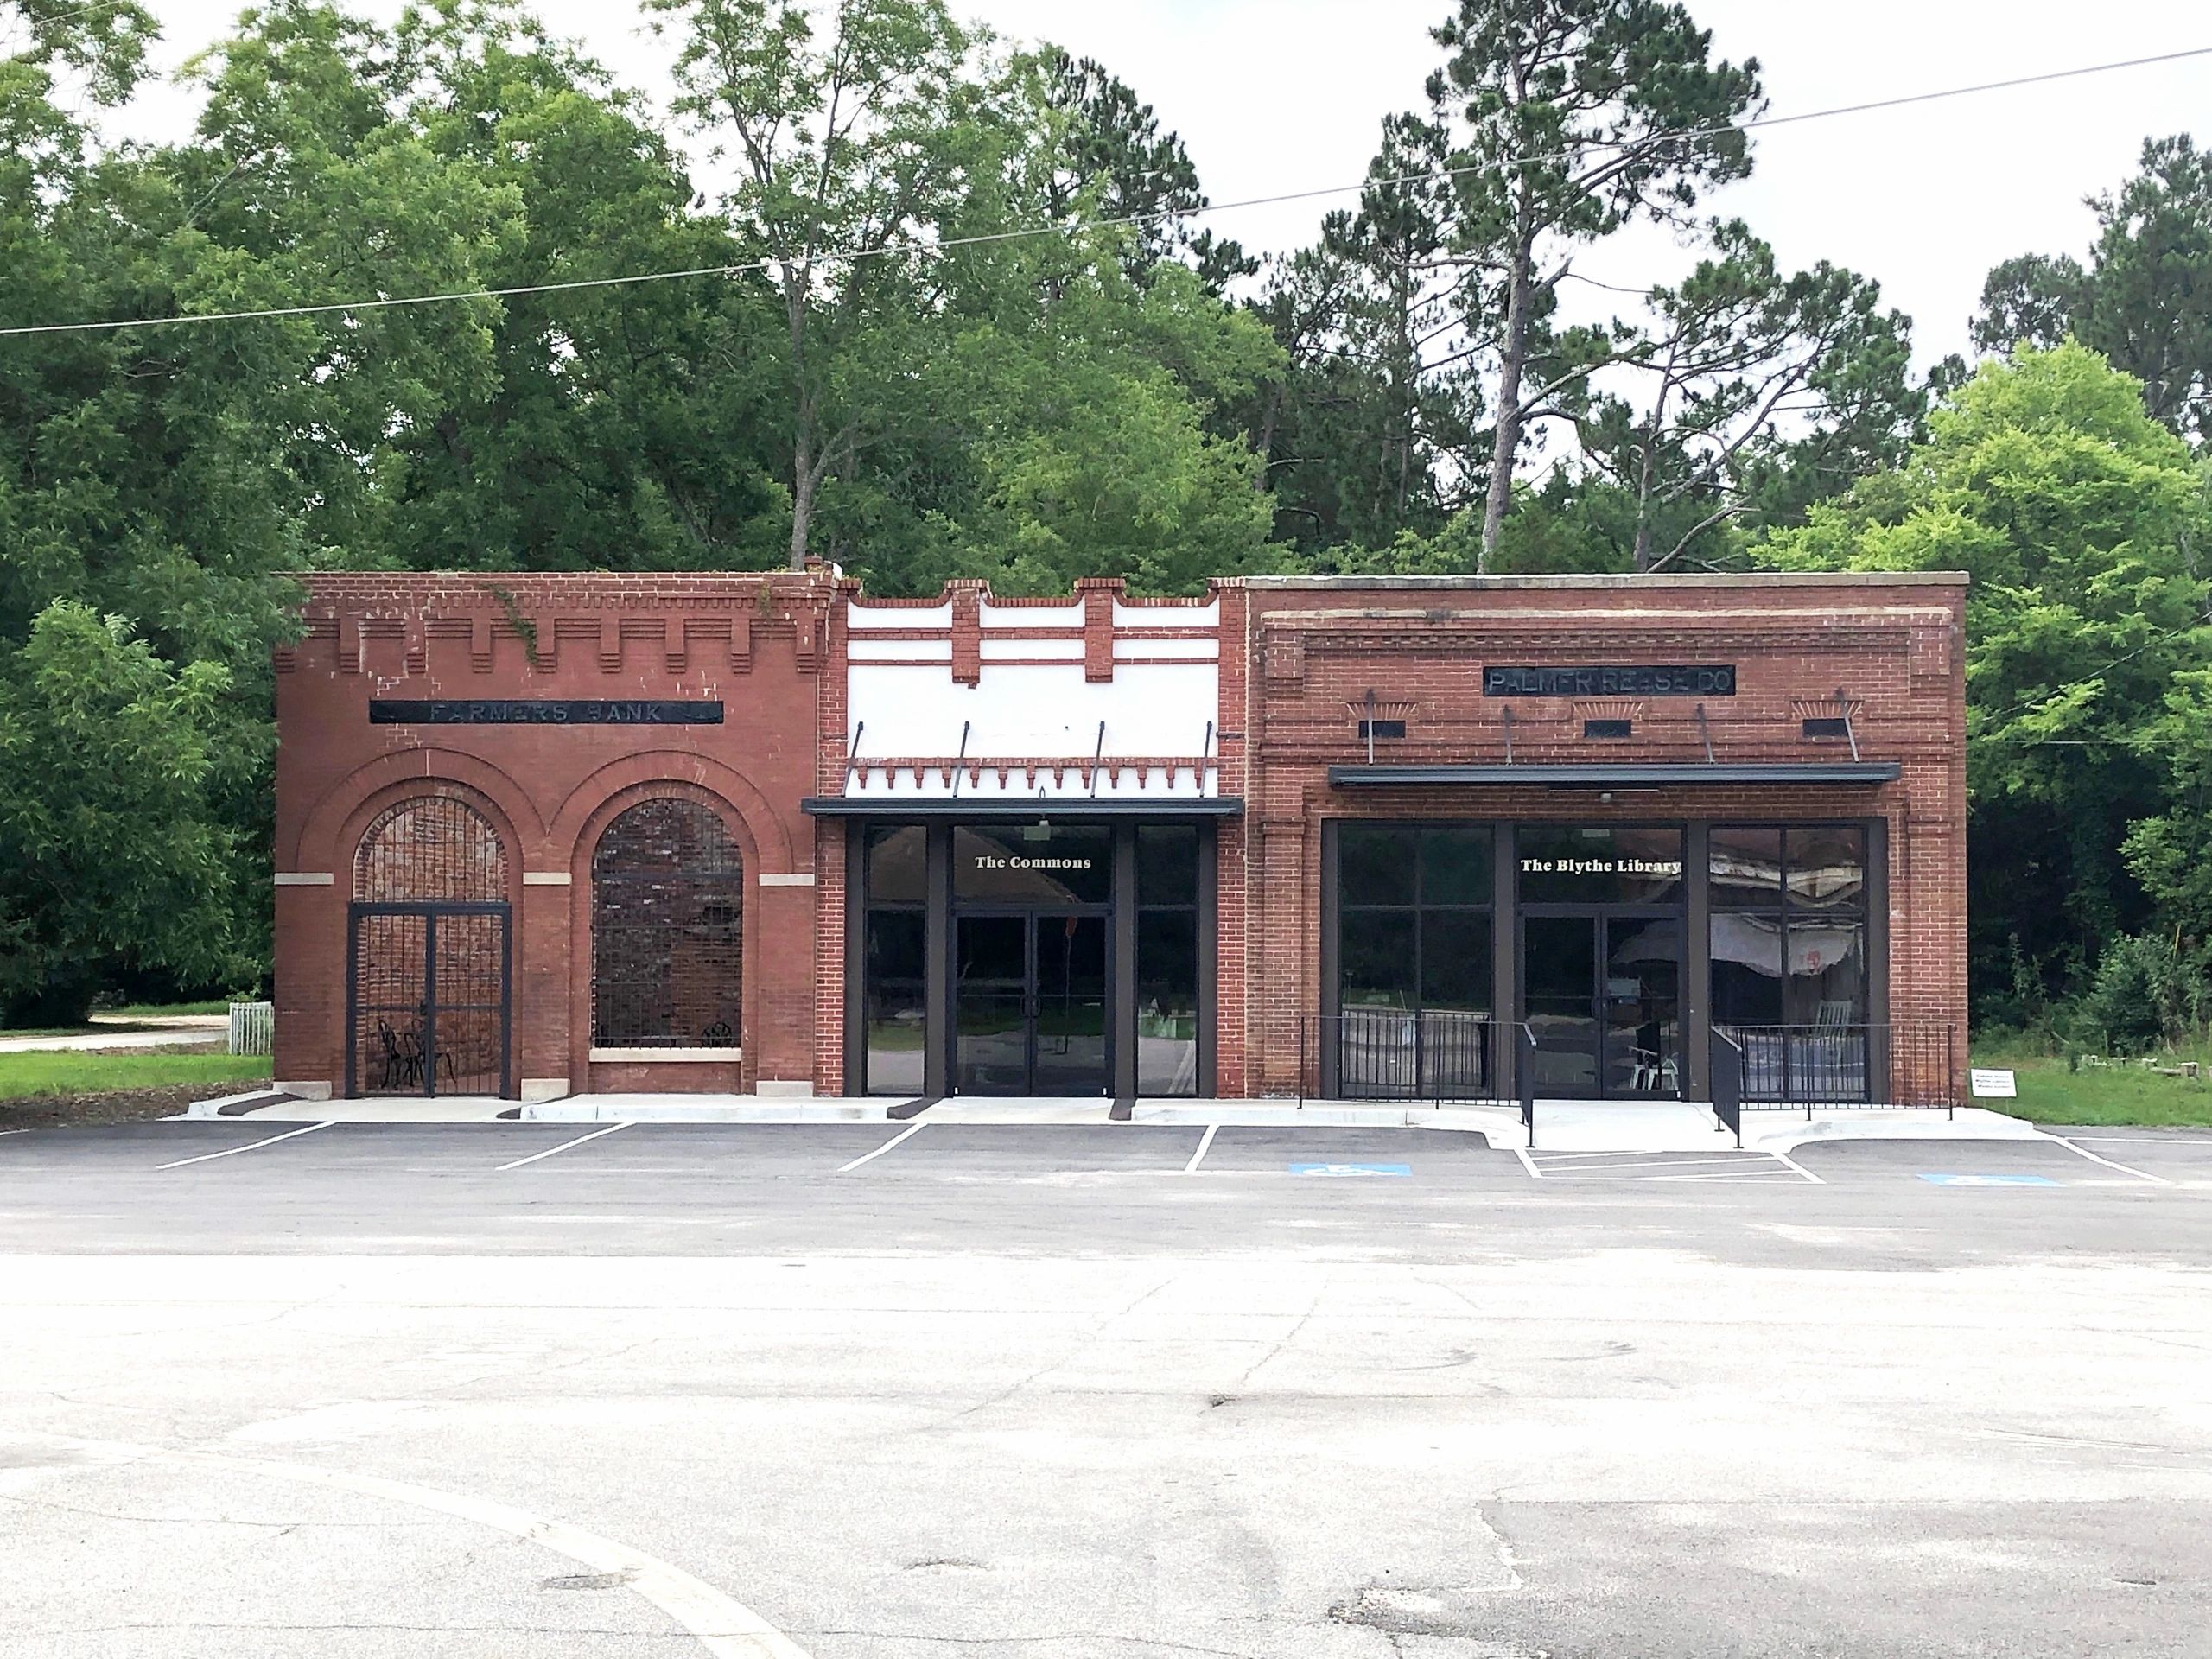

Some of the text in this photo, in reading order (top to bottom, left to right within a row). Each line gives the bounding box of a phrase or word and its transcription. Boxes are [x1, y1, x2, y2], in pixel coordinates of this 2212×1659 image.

[588, 703, 663, 721] BANK
[975, 855, 1092, 869] The Commons
[1520, 858, 1681, 875] The Blythe Library
